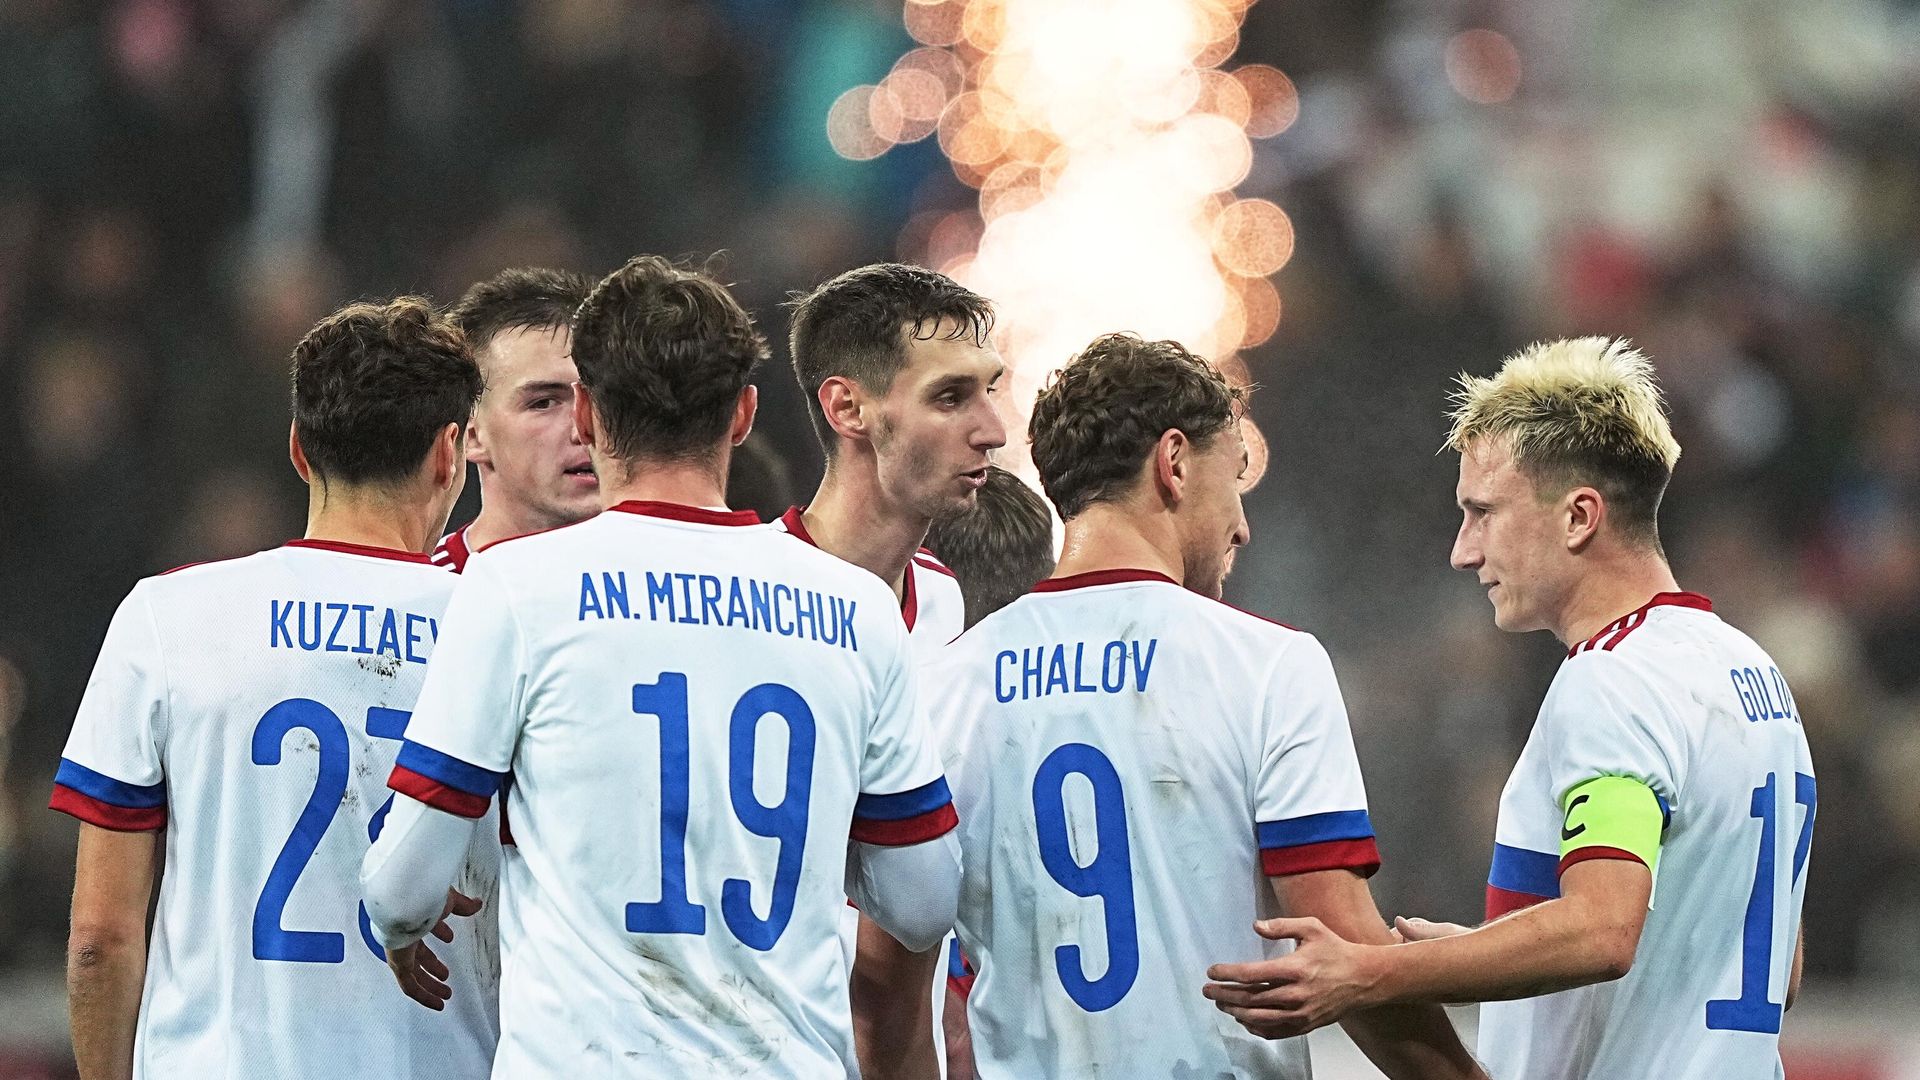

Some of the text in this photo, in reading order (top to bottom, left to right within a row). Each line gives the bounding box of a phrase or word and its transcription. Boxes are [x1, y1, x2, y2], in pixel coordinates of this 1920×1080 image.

[994, 639, 1157, 703] CHALOV
[624, 671, 817, 951] 19
[1032, 742, 1140, 1013] 9
[1561, 794, 1590, 841] C
